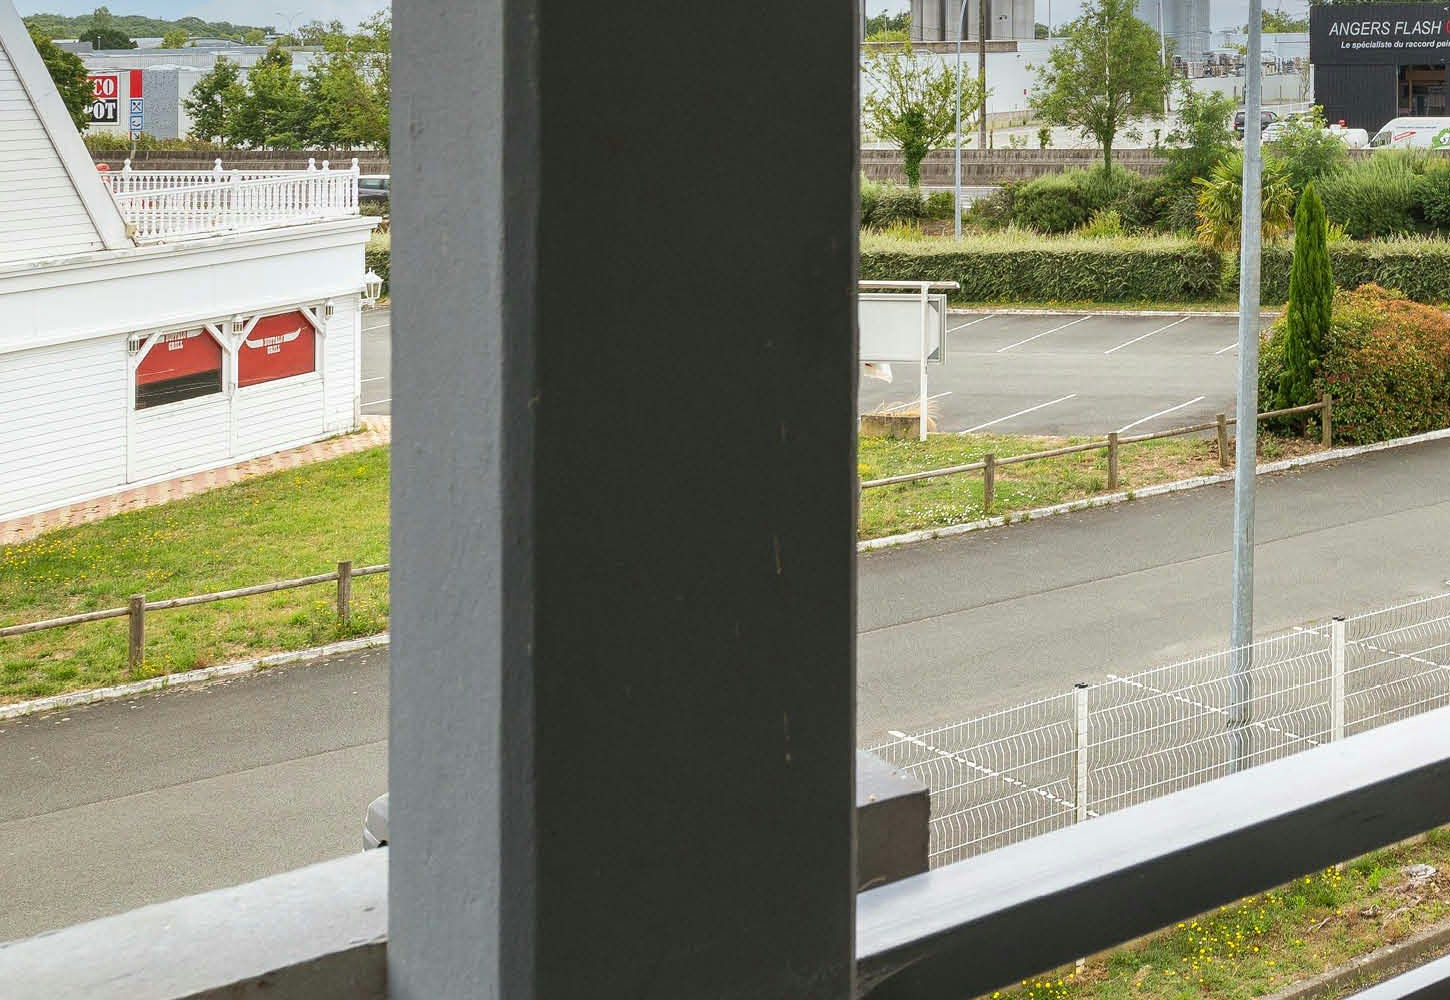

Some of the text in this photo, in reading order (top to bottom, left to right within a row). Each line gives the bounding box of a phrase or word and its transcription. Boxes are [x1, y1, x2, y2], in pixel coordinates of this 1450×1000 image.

[1329, 21, 1391, 36] ANGERS
[1394, 20, 1442, 35] FLASH
[1340, 41, 1351, 49] Le
[1351, 40, 1393, 50] spécialiste
[1394, 40, 1404, 48] du
[1405, 40, 1435, 48] raccord
